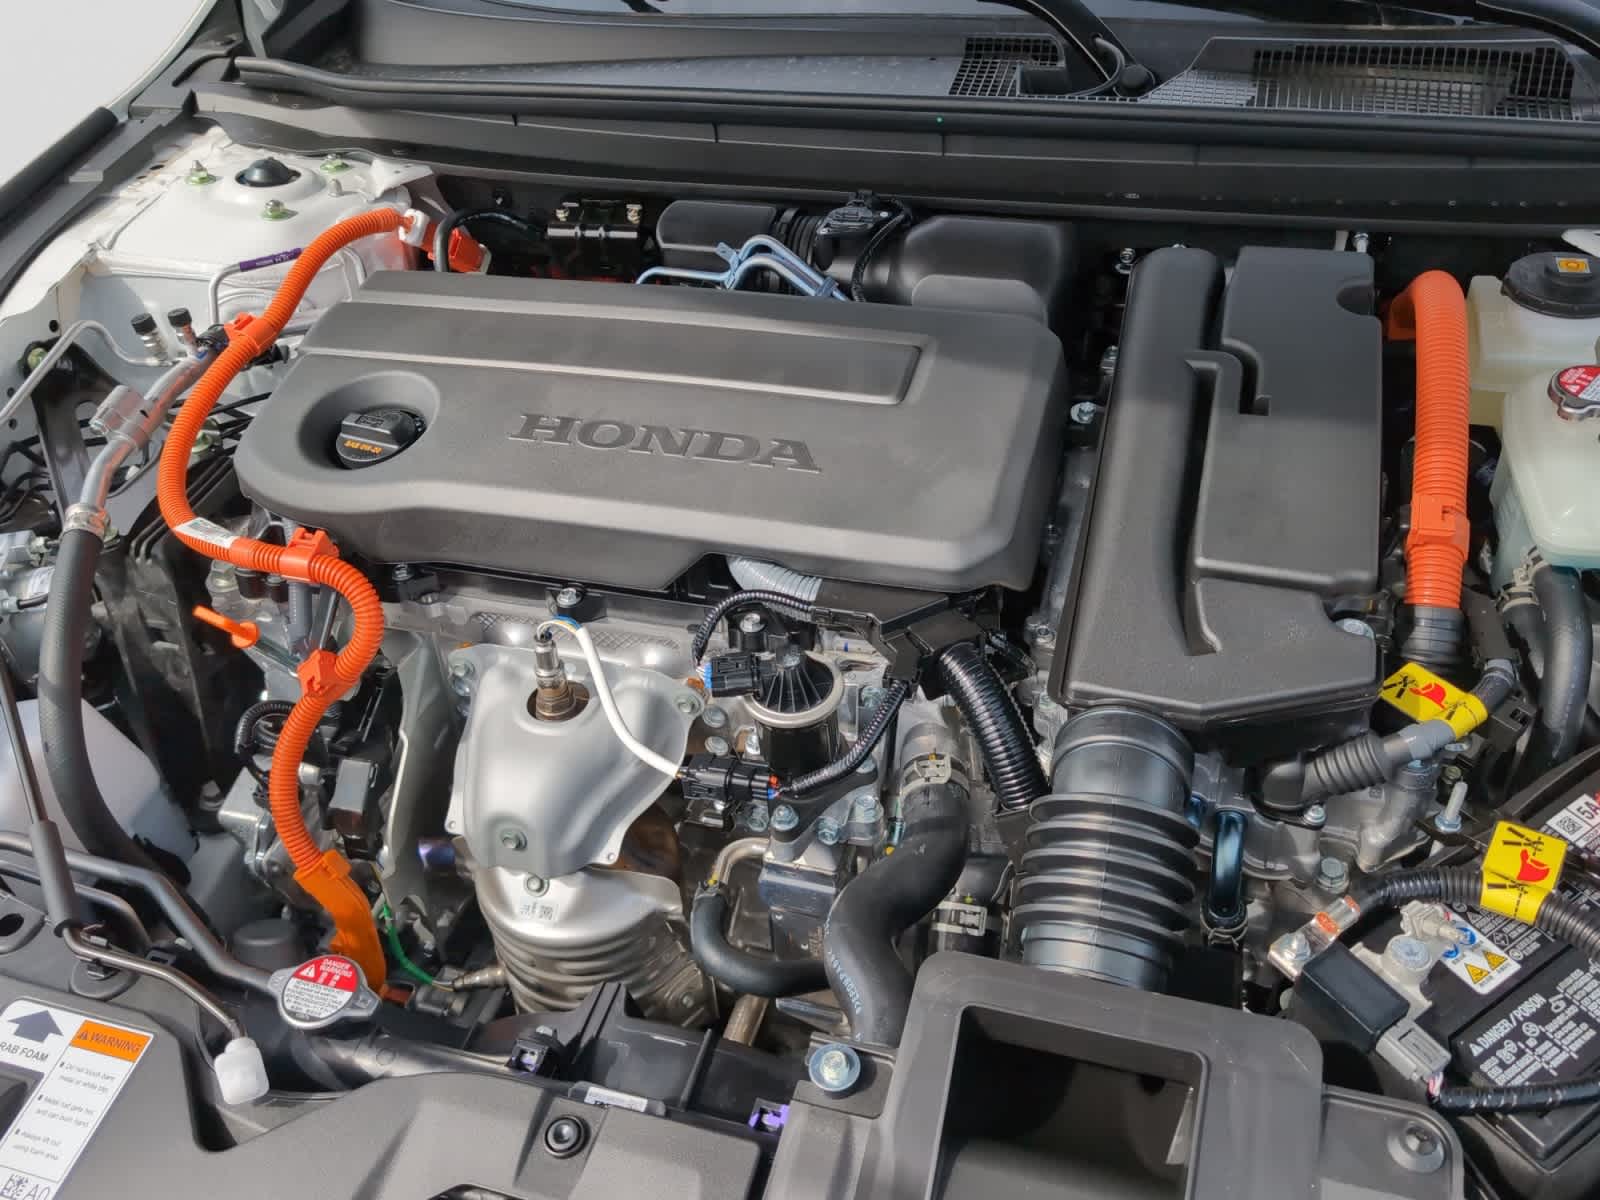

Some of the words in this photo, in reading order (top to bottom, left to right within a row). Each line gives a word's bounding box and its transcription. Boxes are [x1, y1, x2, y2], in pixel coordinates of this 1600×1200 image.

[508, 413, 822, 474] HONDA
[90, 1031, 142, 1053] WARNING
[20, 1047, 49, 1061] FOAM
